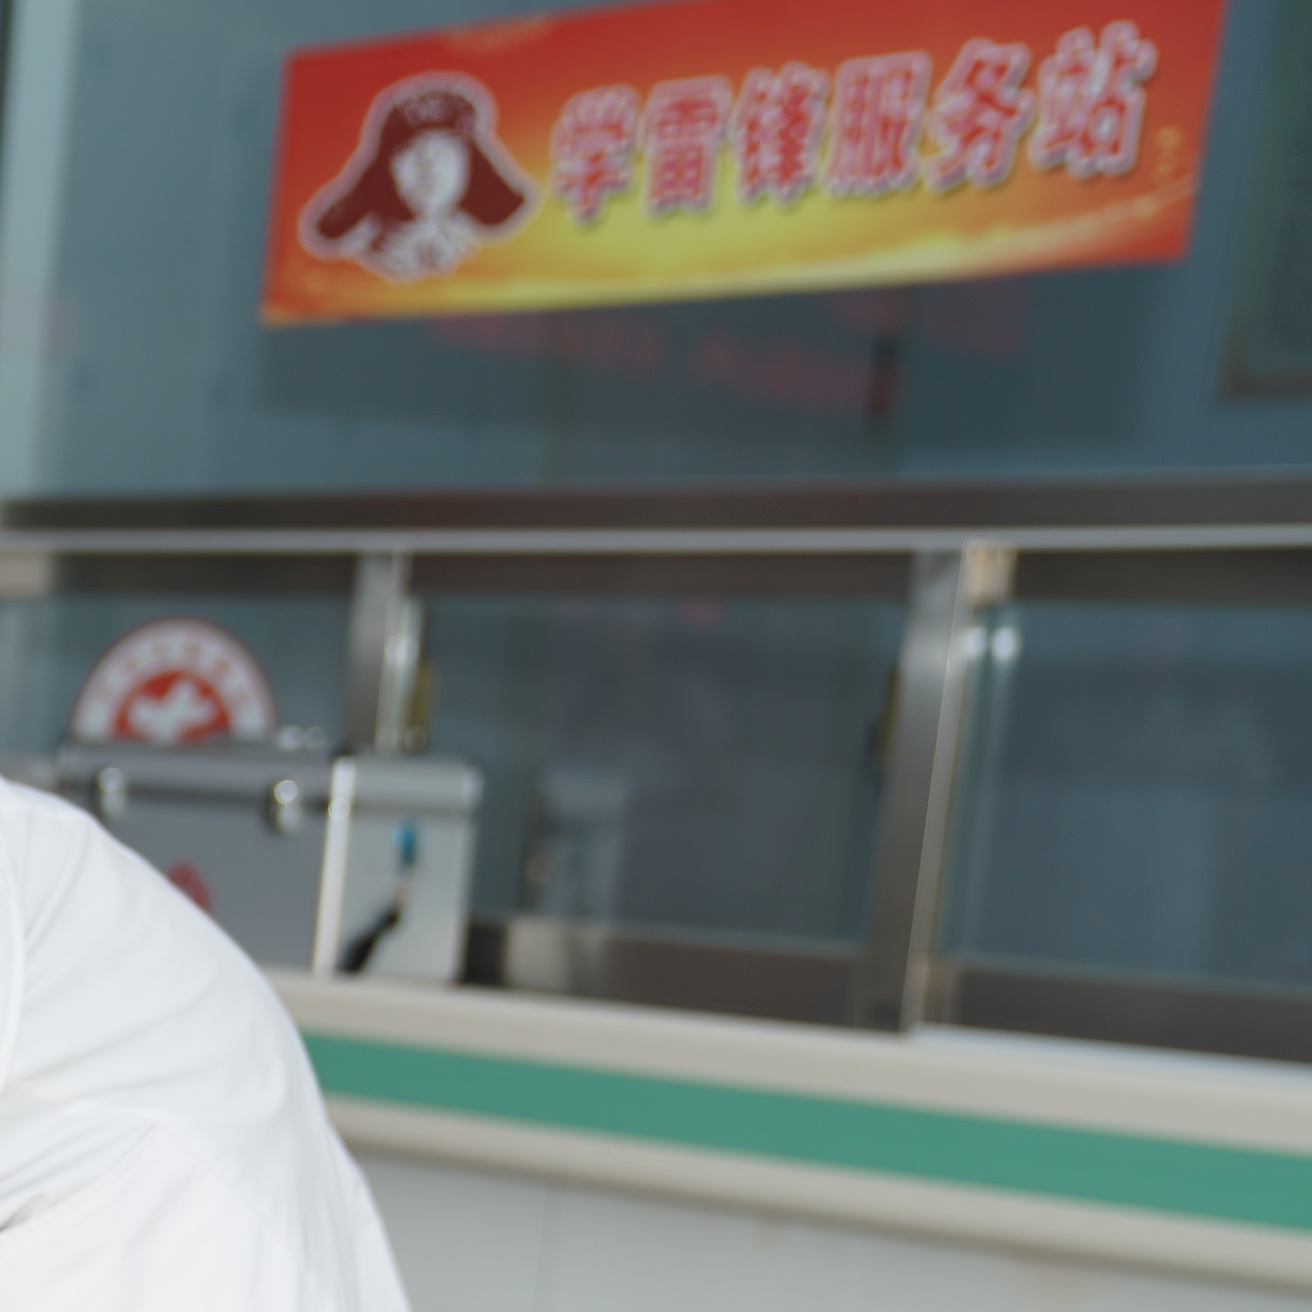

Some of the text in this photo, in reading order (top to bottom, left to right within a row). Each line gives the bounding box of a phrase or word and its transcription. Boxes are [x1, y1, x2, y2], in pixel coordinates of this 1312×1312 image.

[550, 20, 1154, 229] 学雷锋服务站
